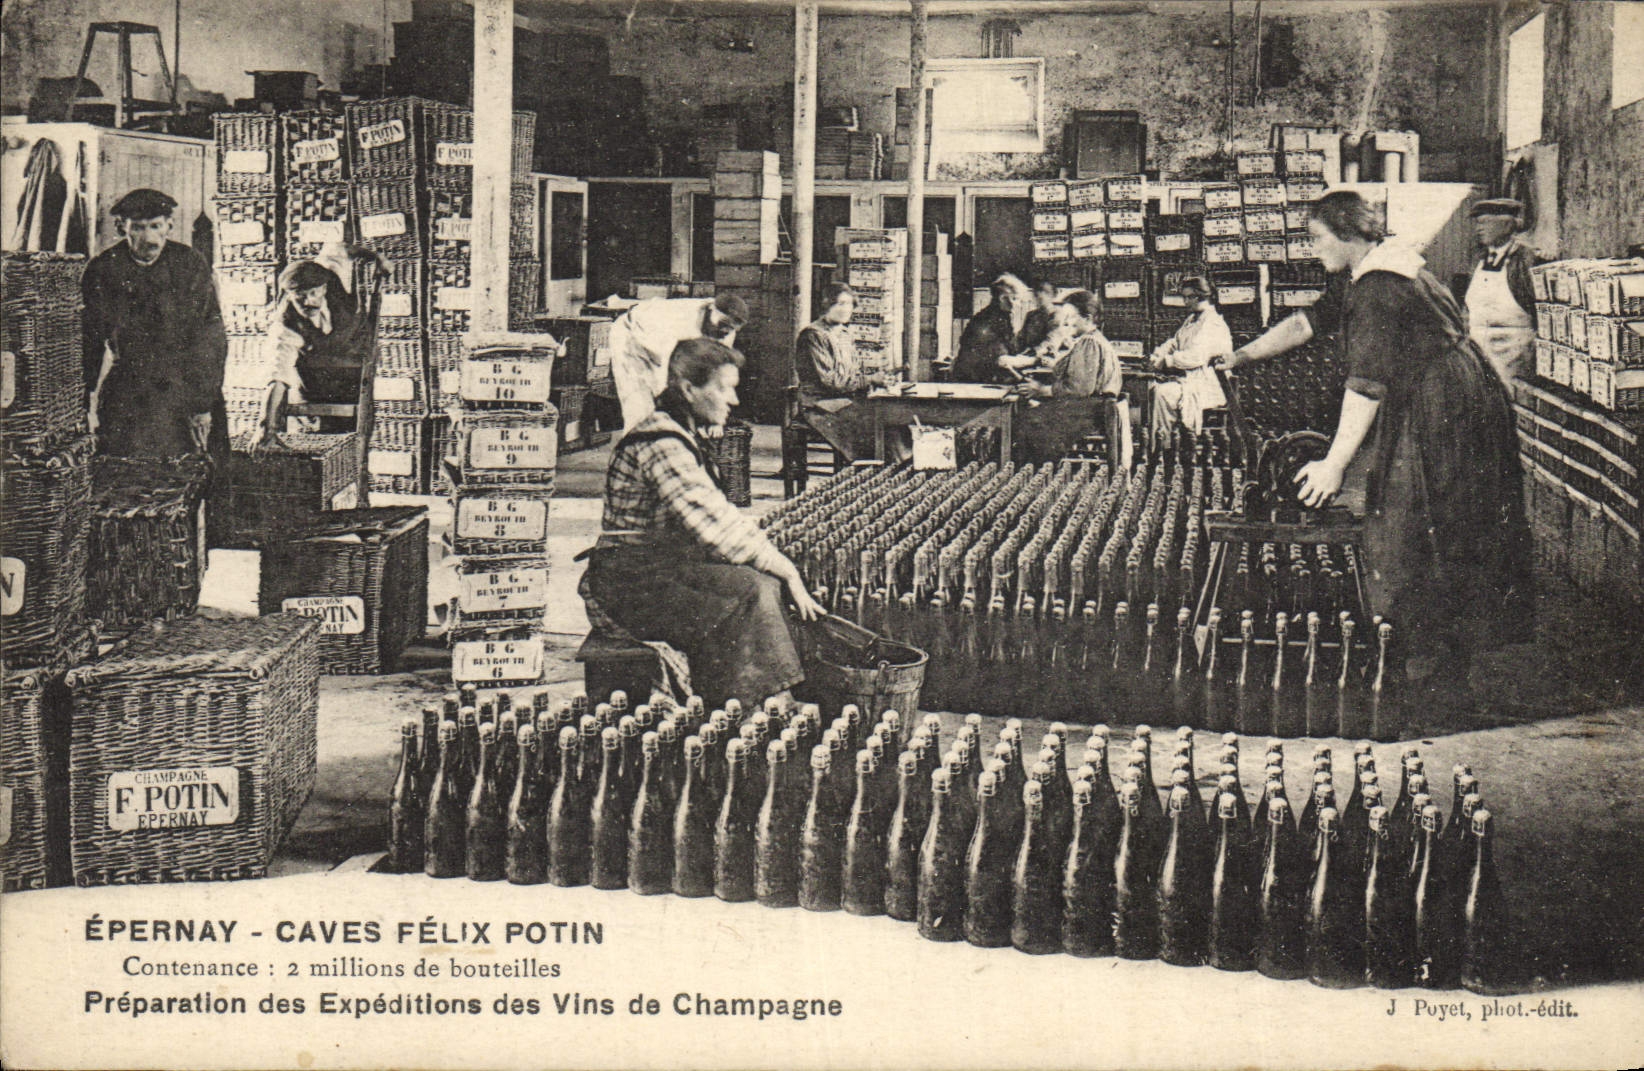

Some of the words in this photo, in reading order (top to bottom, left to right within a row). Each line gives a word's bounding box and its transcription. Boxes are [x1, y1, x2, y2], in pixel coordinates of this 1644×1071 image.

[493, 363, 502, 374] B
[496, 386, 515, 399] 10
[500, 429, 510, 441] B
[506, 453, 517, 465] 9
[488, 501, 497, 512] B
[494, 524, 505, 537] 8
[489, 574, 499, 585] B
[498, 595, 508, 608] 7
[485, 643, 495, 654] B
[492, 667, 503, 679] 6
[135, 770, 208, 784] CHAMPAGNE
[144, 782, 230, 812] POTIN
[138, 811, 208, 829] EPERNAY
